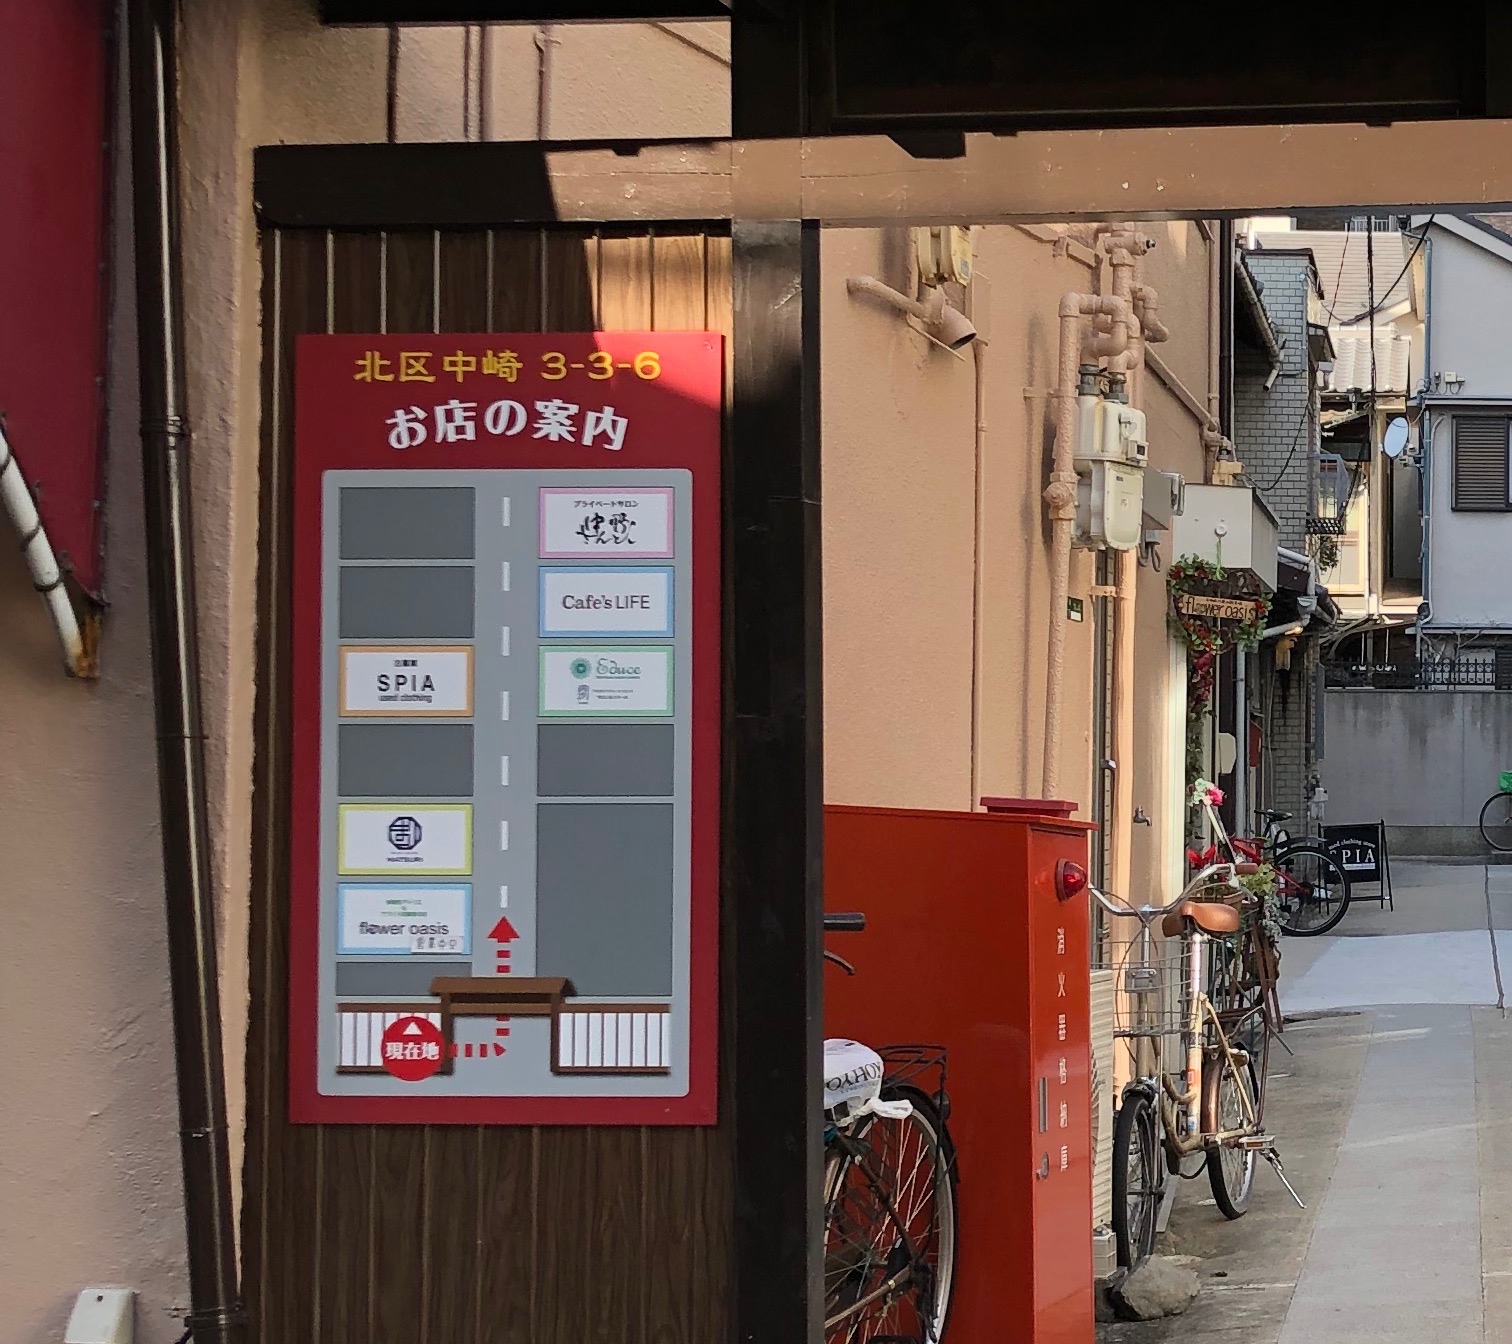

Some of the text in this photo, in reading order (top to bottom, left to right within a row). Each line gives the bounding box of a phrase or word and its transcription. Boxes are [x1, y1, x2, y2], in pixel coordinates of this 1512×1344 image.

[353, 350, 662, 383] 北区中崎 3-3-6
[385, 399, 629, 451] お店の案内
[574, 500, 639, 508] プライベートサロン
[562, 594, 650, 609] Cafe's LIFE
[376, 673, 435, 692] SPIA
[359, 921, 450, 935] flower oasis
[384, 1041, 440, 1061] 現在地
